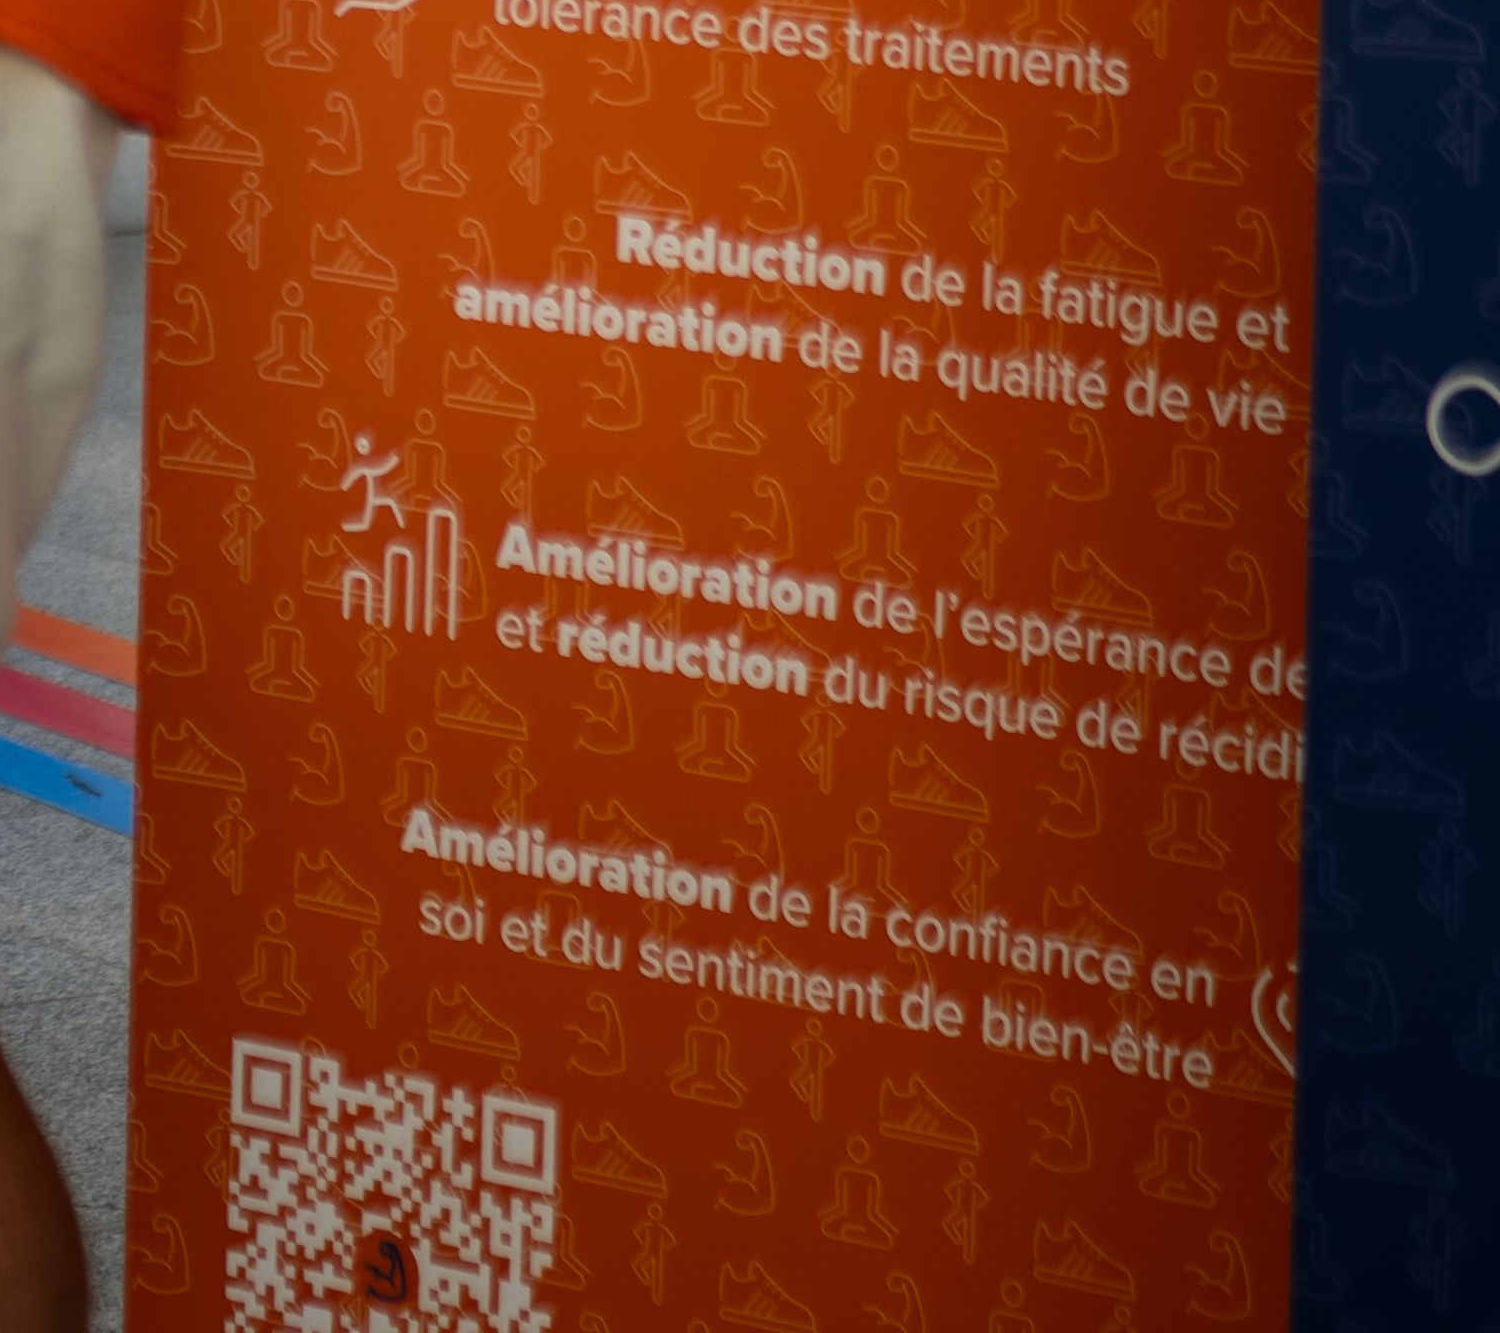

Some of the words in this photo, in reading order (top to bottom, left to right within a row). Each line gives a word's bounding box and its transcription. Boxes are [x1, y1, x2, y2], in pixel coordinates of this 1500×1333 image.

[736, 4, 828, 61] des
[844, 14, 1131, 97] traitements
[454, 278, 783, 362] amélioration
[798, 314, 863, 371] de
[879, 322, 922, 379] la
[937, 331, 1108, 409] qualité
[1125, 362, 1190, 419] de
[1207, 373, 1288, 436] vie
[616, 211, 885, 297] Réduction
[901, 246, 966, 303] de
[982, 257, 1025, 314] la
[1040, 263, 1218, 350] fatigue
[1236, 297, 1291, 352] et
[496, 525, 838, 621] Amélioration
[851, 573, 918, 632] de
[933, 586, 1232, 691] l'espérance
[496, 604, 545, 654] et
[557, 610, 809, 698] réduction
[824, 650, 889, 709] du
[903, 665, 1058, 746] risque
[1076, 691, 1140, 755] de
[401, 805, 733, 914] Amélioration
[747, 866, 811, 927] de
[827, 877, 869, 938] la
[885, 895, 1131, 991] confiance
[1150, 956, 1216, 1008] en
[417, 890, 486, 947] soi
[500, 903, 548, 958] et
[560, 910, 624, 971] du
[637, 930, 884, 1026] sentiment
[898, 969, 964, 1032] de
[980, 984, 1213, 1089] bien-être
